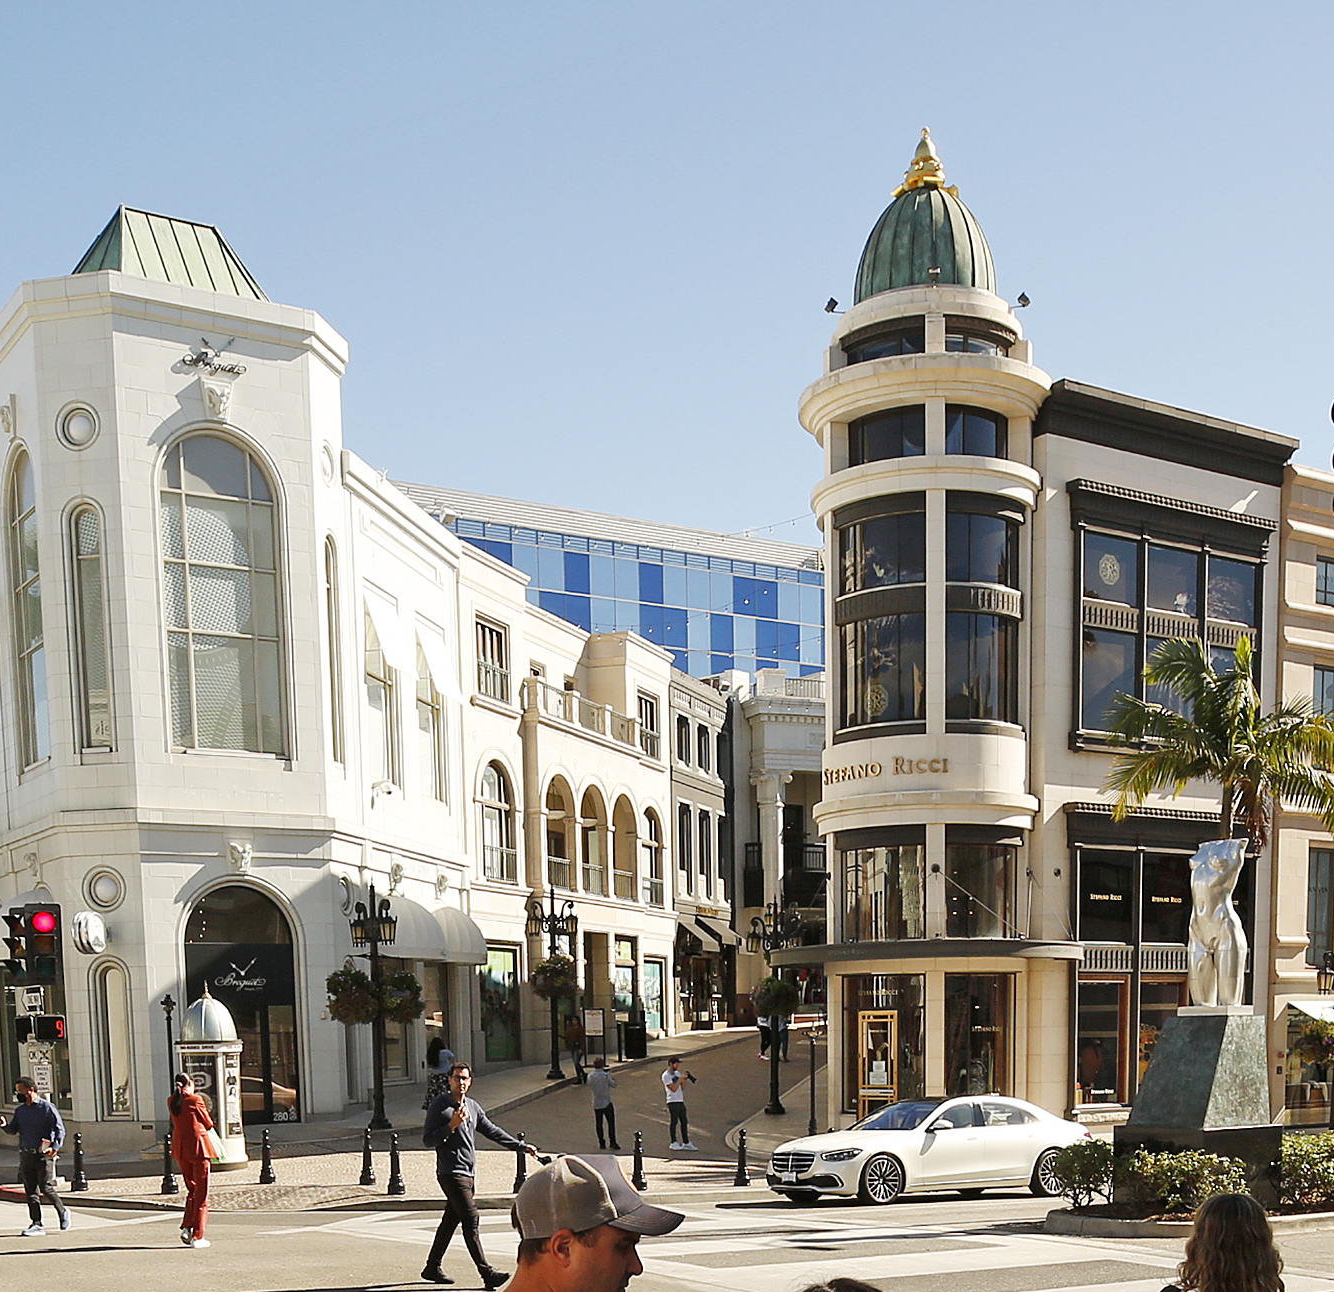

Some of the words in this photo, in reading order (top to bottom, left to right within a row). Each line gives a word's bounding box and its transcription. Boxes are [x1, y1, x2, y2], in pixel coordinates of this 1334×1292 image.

[823, 761, 882, 786] STEFANO
[892, 756, 949, 775] RICCI
[214, 972, 267, 992] Breguet
[55, 1020, 64, 1037] 9
[273, 1111, 289, 1122] 280
